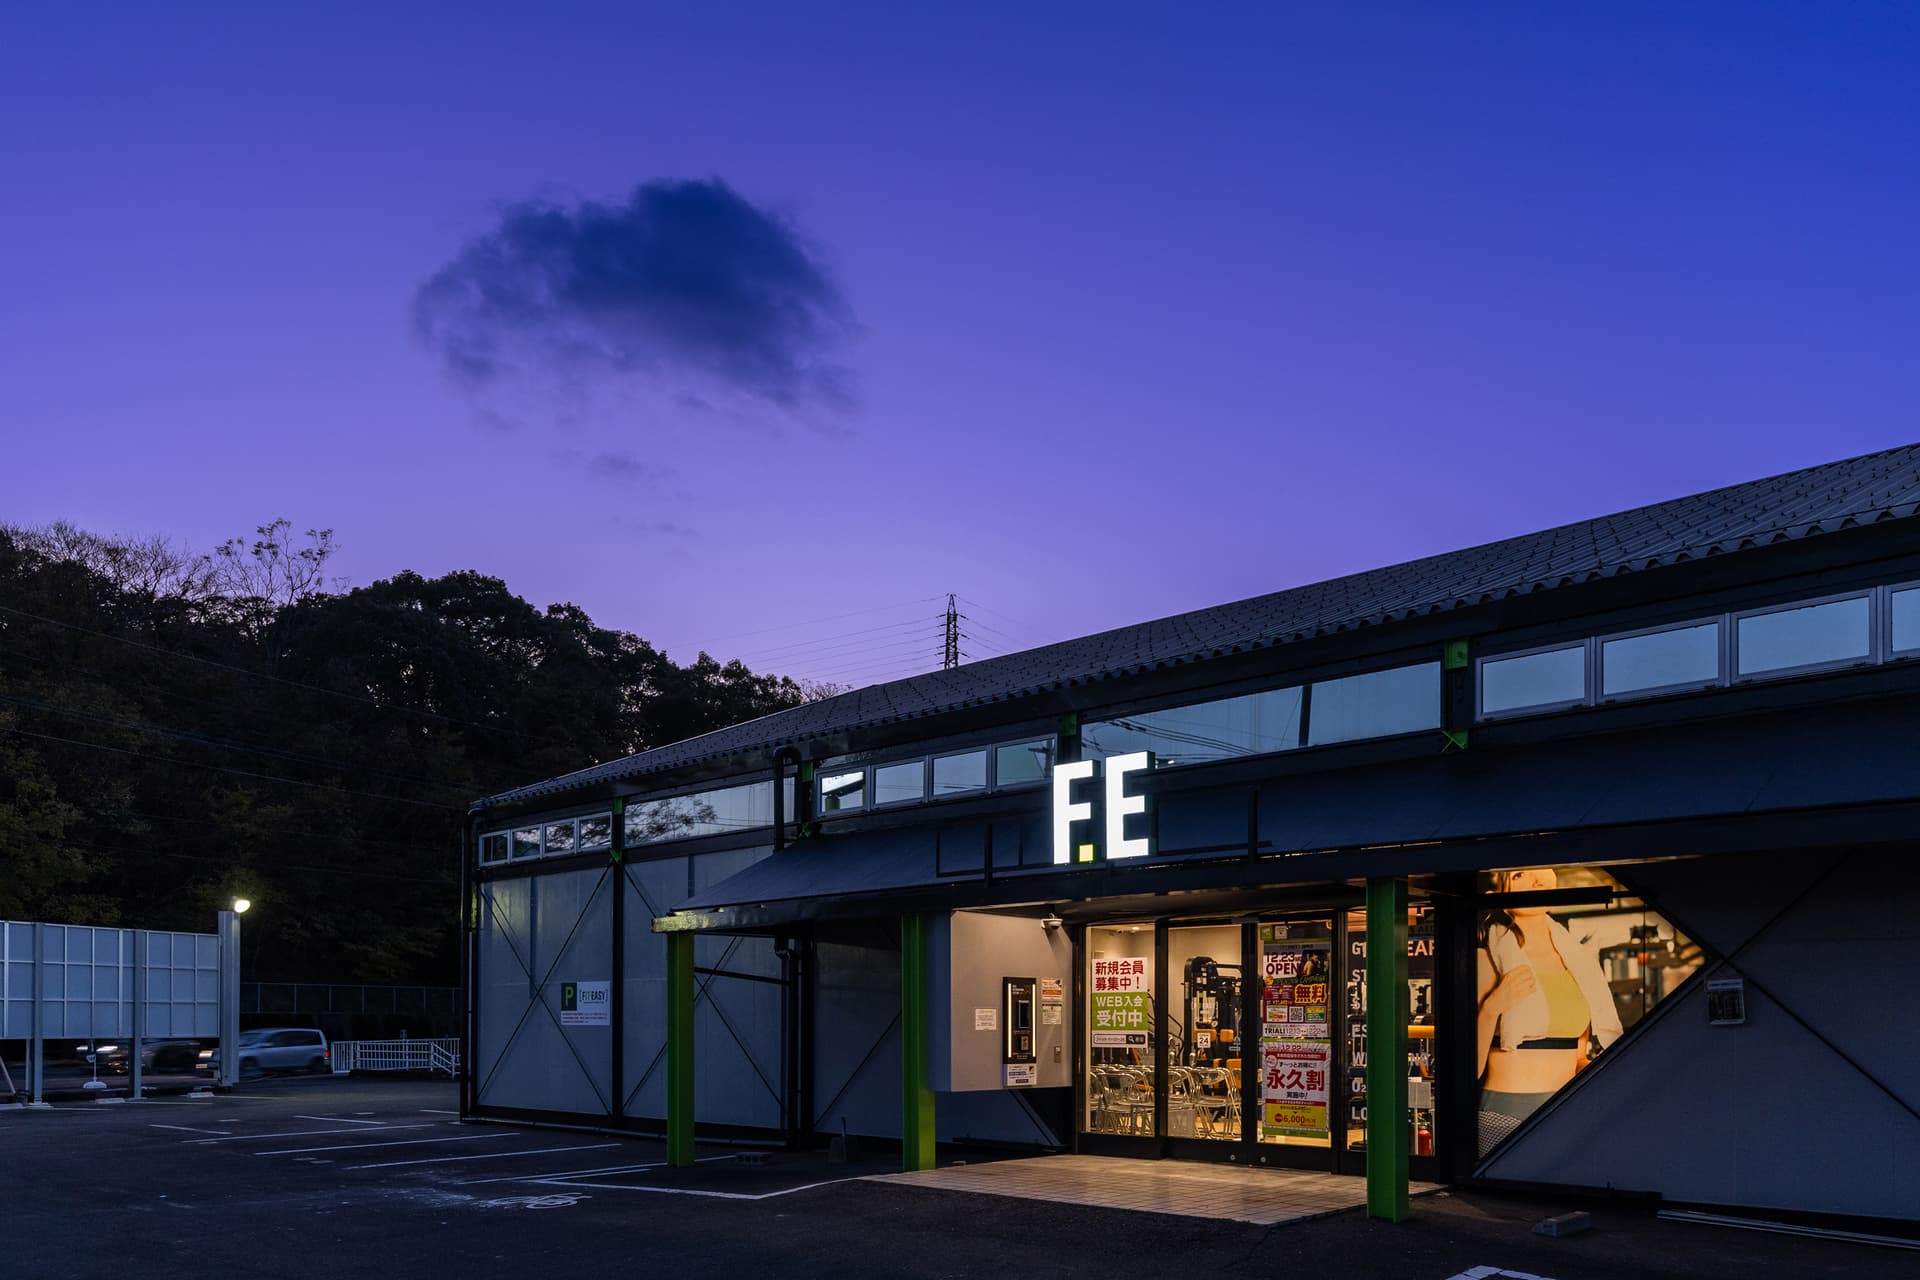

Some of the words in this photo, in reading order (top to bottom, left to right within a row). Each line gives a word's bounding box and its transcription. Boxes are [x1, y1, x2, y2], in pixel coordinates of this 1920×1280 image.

[1095, 960, 1145, 976] 新規会員
[1265, 962, 1299, 976] OPEN
[564, 985, 574, 1008] P
[1095, 995, 1144, 1008] WEB入会
[1096, 1009, 1143, 1028] 受付中
[1266, 1068, 1325, 1092] 永久割
